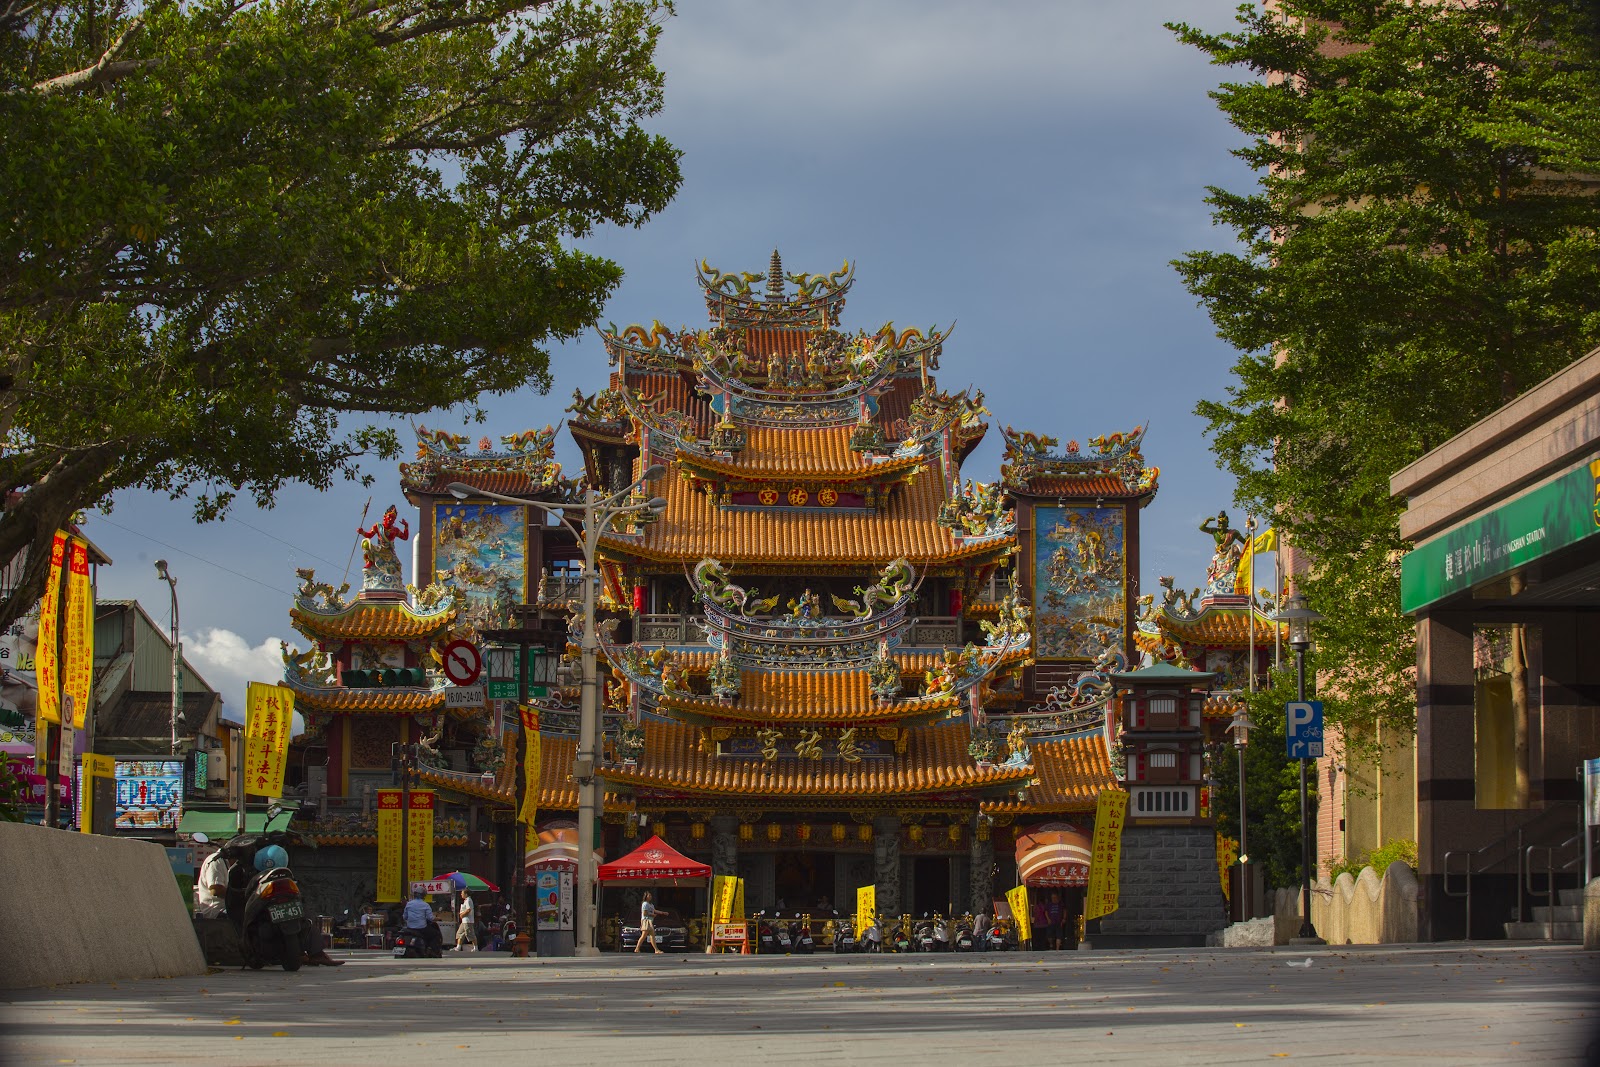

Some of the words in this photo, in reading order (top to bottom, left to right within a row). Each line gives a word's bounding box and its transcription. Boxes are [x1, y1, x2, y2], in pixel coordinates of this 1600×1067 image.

[1445, 535, 1490, 581] 捷運松山站
[1503, 536, 1526, 556] SONGSHAN
[1526, 527, 1546, 545] STATION
[1288, 702, 1314, 737] P
[256, 696, 280, 790] 秋季禮斗法會
